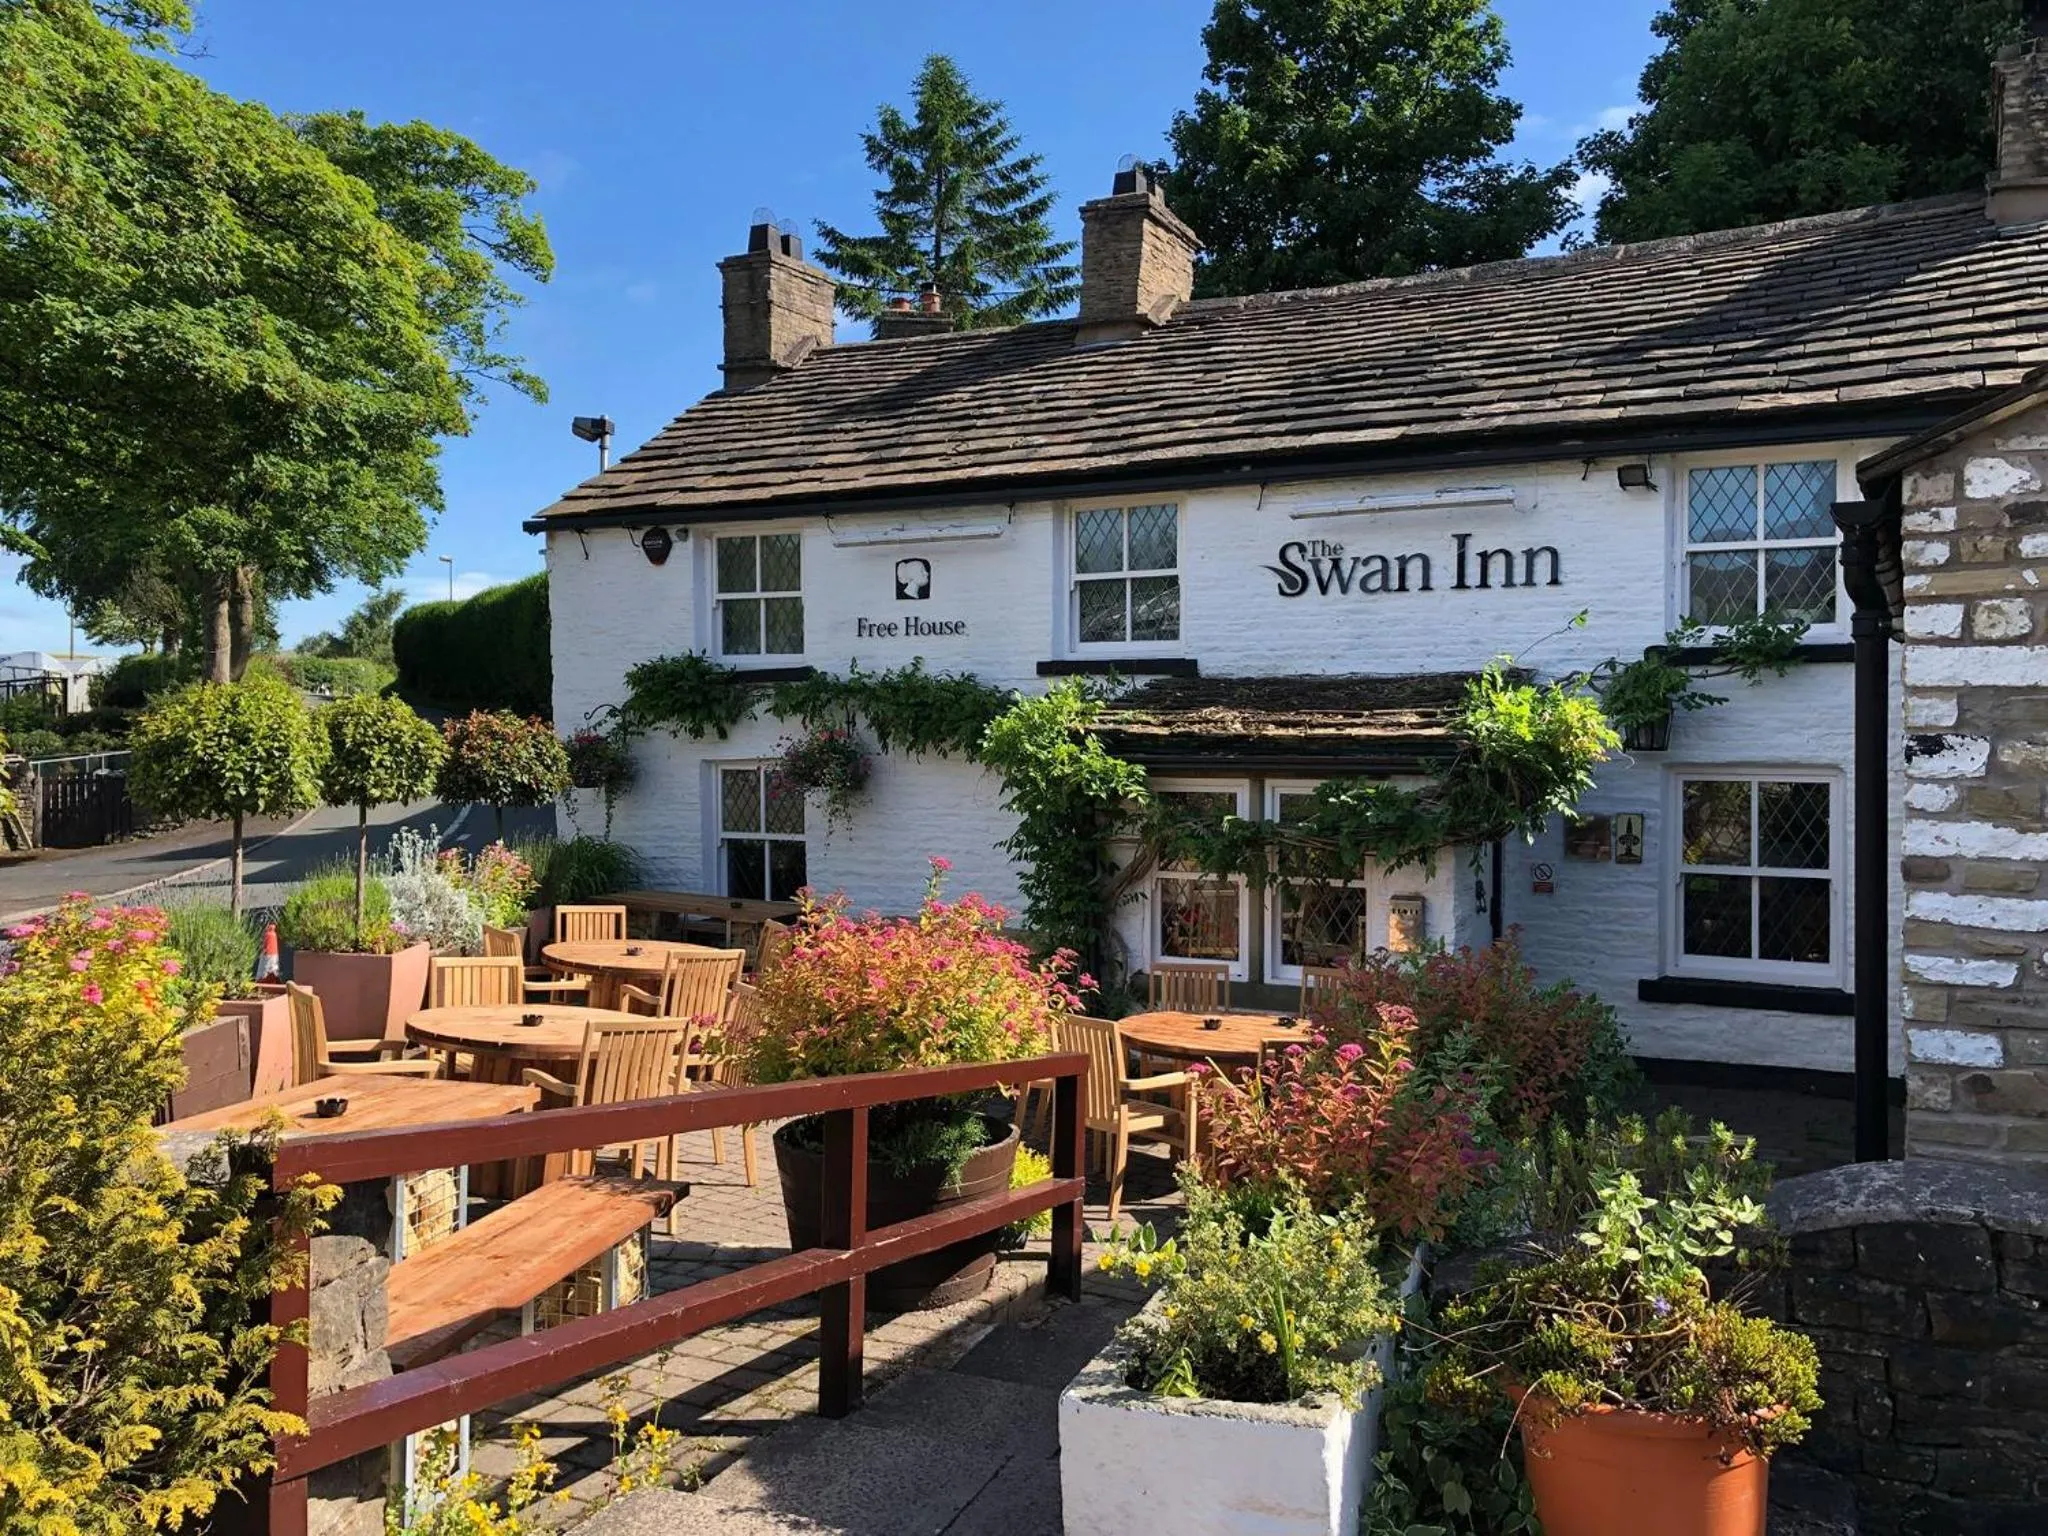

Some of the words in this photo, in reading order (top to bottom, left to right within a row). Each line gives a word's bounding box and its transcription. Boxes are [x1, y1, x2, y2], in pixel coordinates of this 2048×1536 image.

[1307, 540, 1344, 557] The
[1277, 541, 1434, 597] Swan
[1450, 533, 1562, 590] Inn
[856, 617, 898, 638] Free
[904, 616, 966, 636] House
